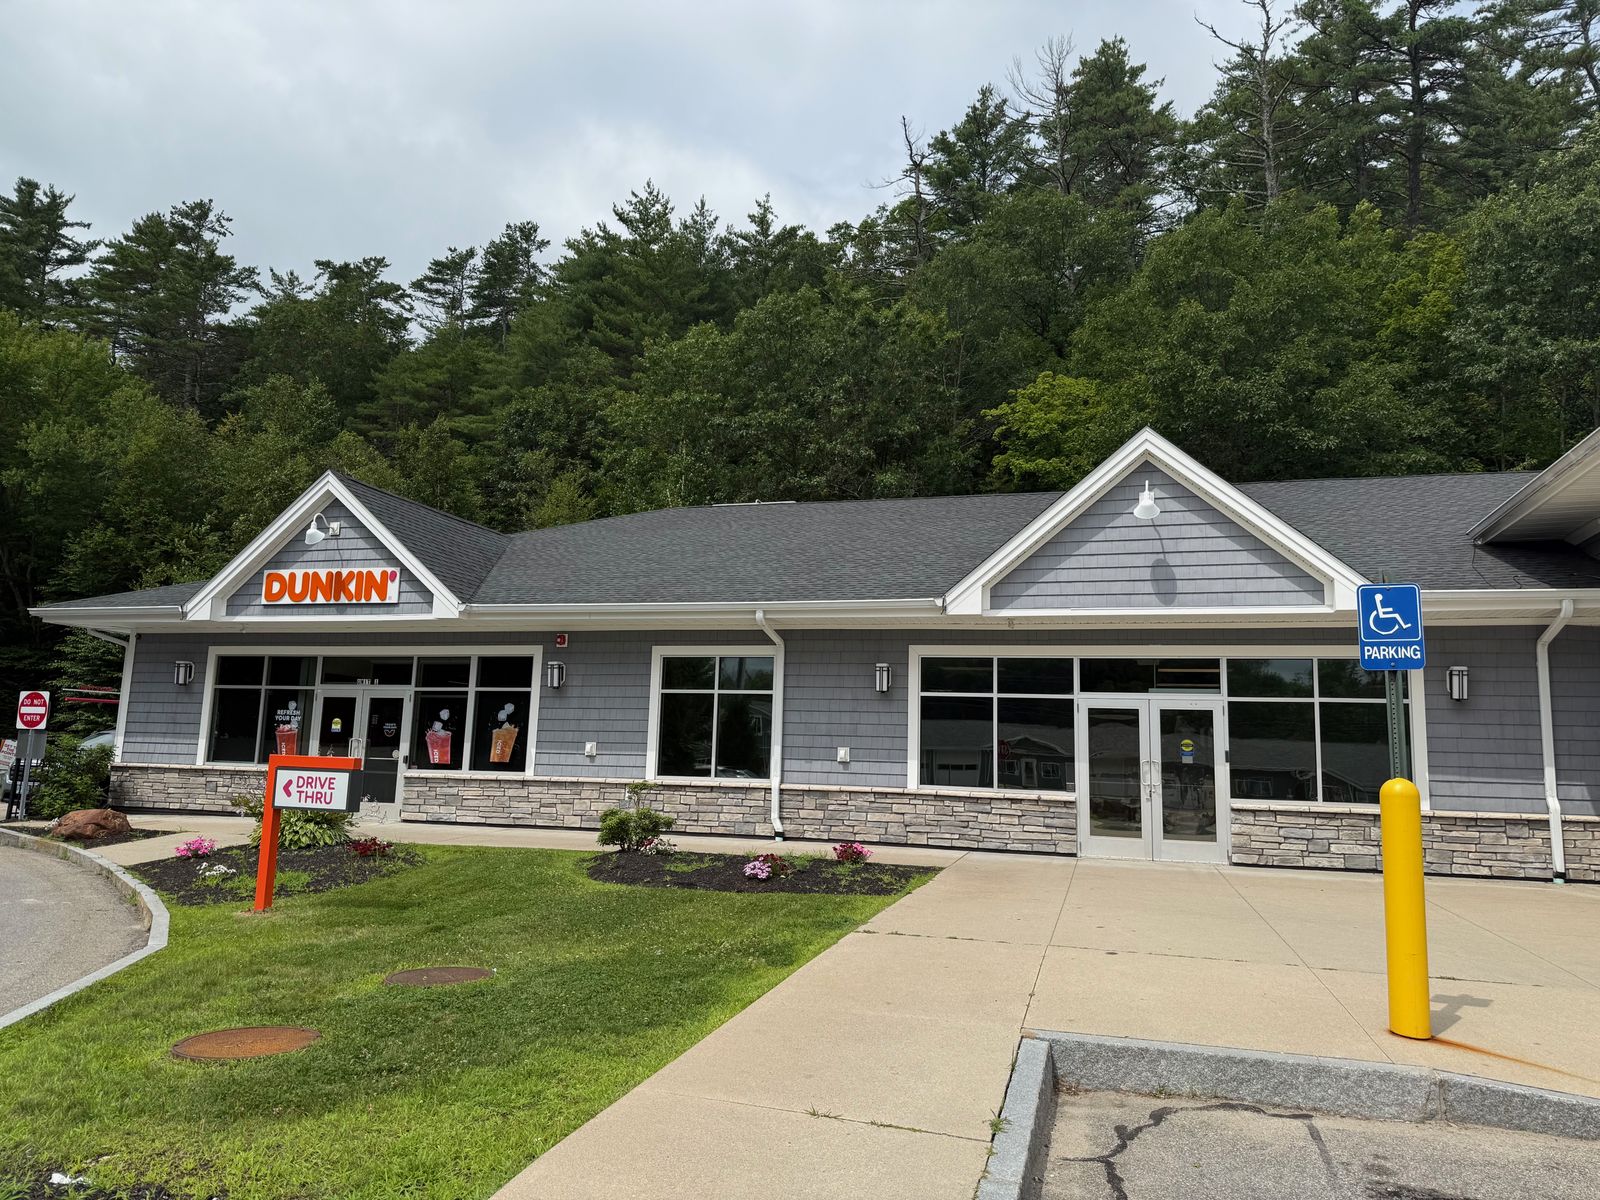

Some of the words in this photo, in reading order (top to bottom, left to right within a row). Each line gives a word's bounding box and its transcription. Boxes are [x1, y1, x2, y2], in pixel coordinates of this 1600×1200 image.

[264, 570, 397, 602] DUNKIN'
[1364, 645, 1421, 660] PARKING
[296, 775, 336, 790] DRIVE
[296, 790, 333, 805] THRU
